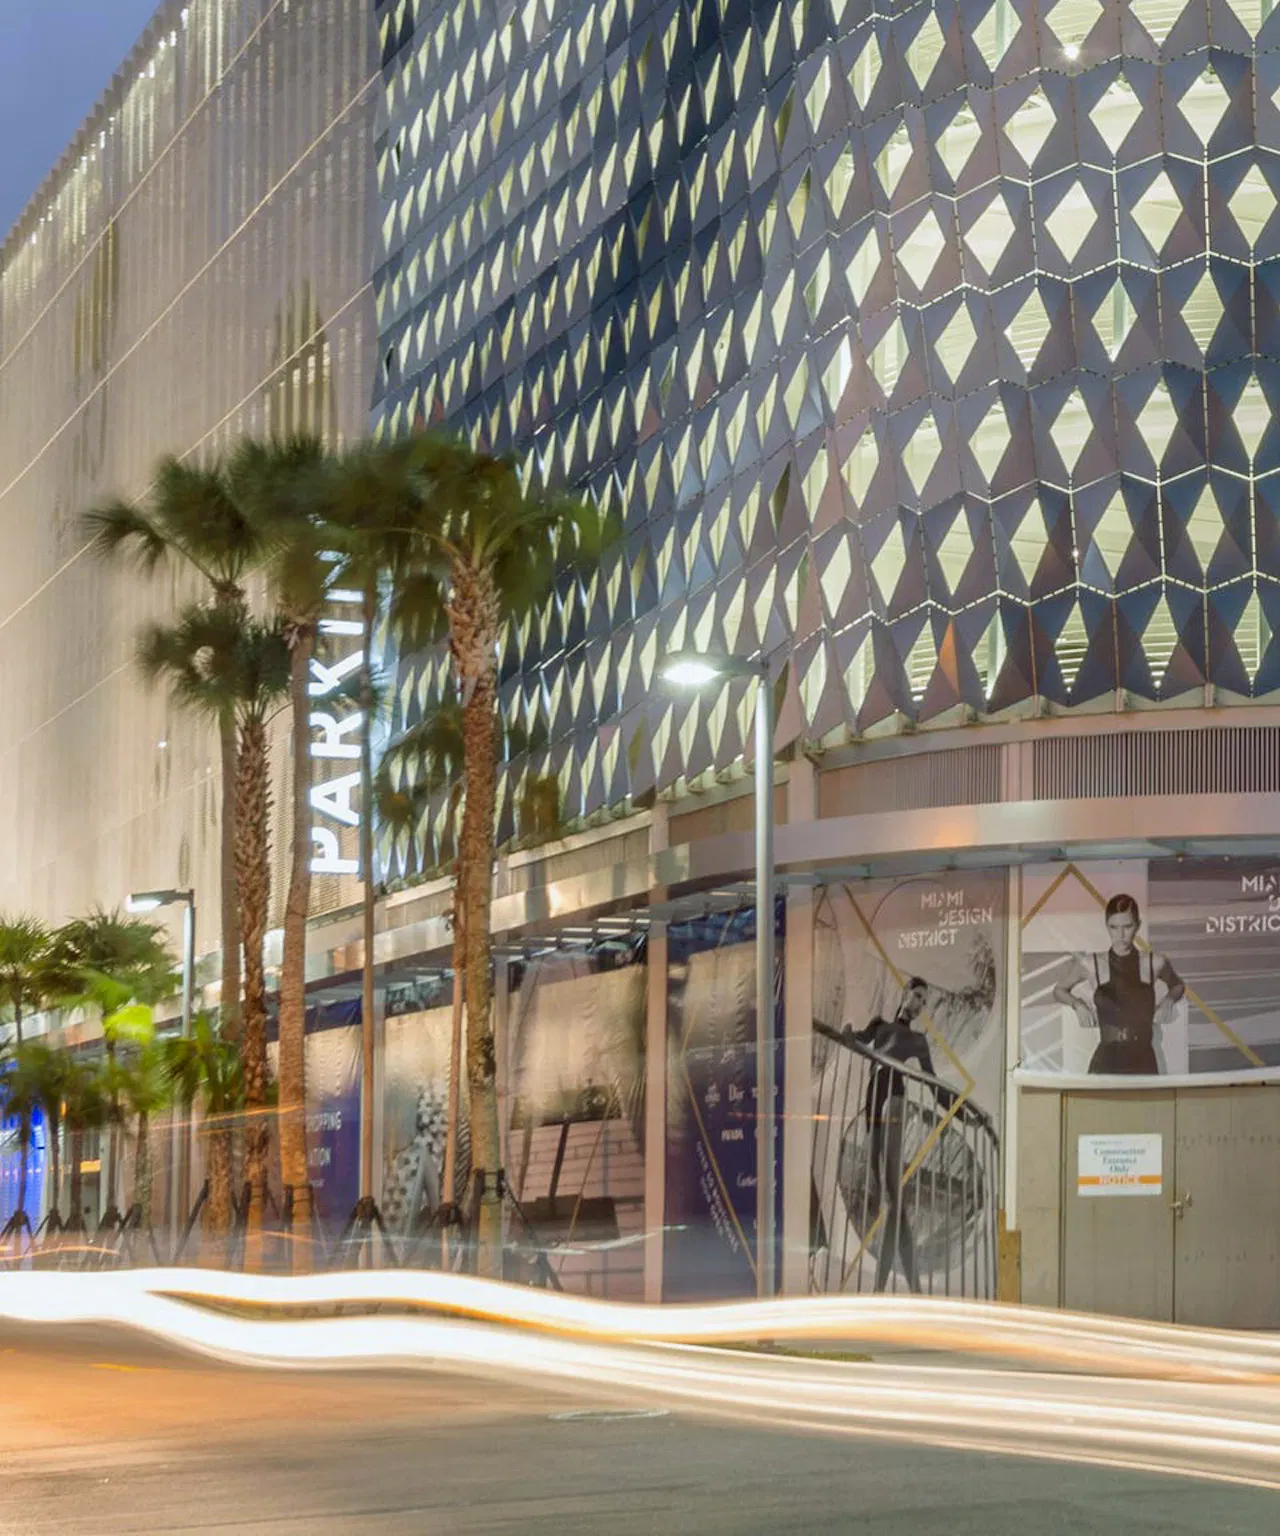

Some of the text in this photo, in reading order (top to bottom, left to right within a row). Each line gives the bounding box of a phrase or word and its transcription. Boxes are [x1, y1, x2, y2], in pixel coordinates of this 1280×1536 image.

[308, 514, 365, 875] PARKIN
[920, 889, 964, 909] MIAMI
[938, 906, 993, 926] DESIGN
[898, 928, 959, 949] DISTRICT
